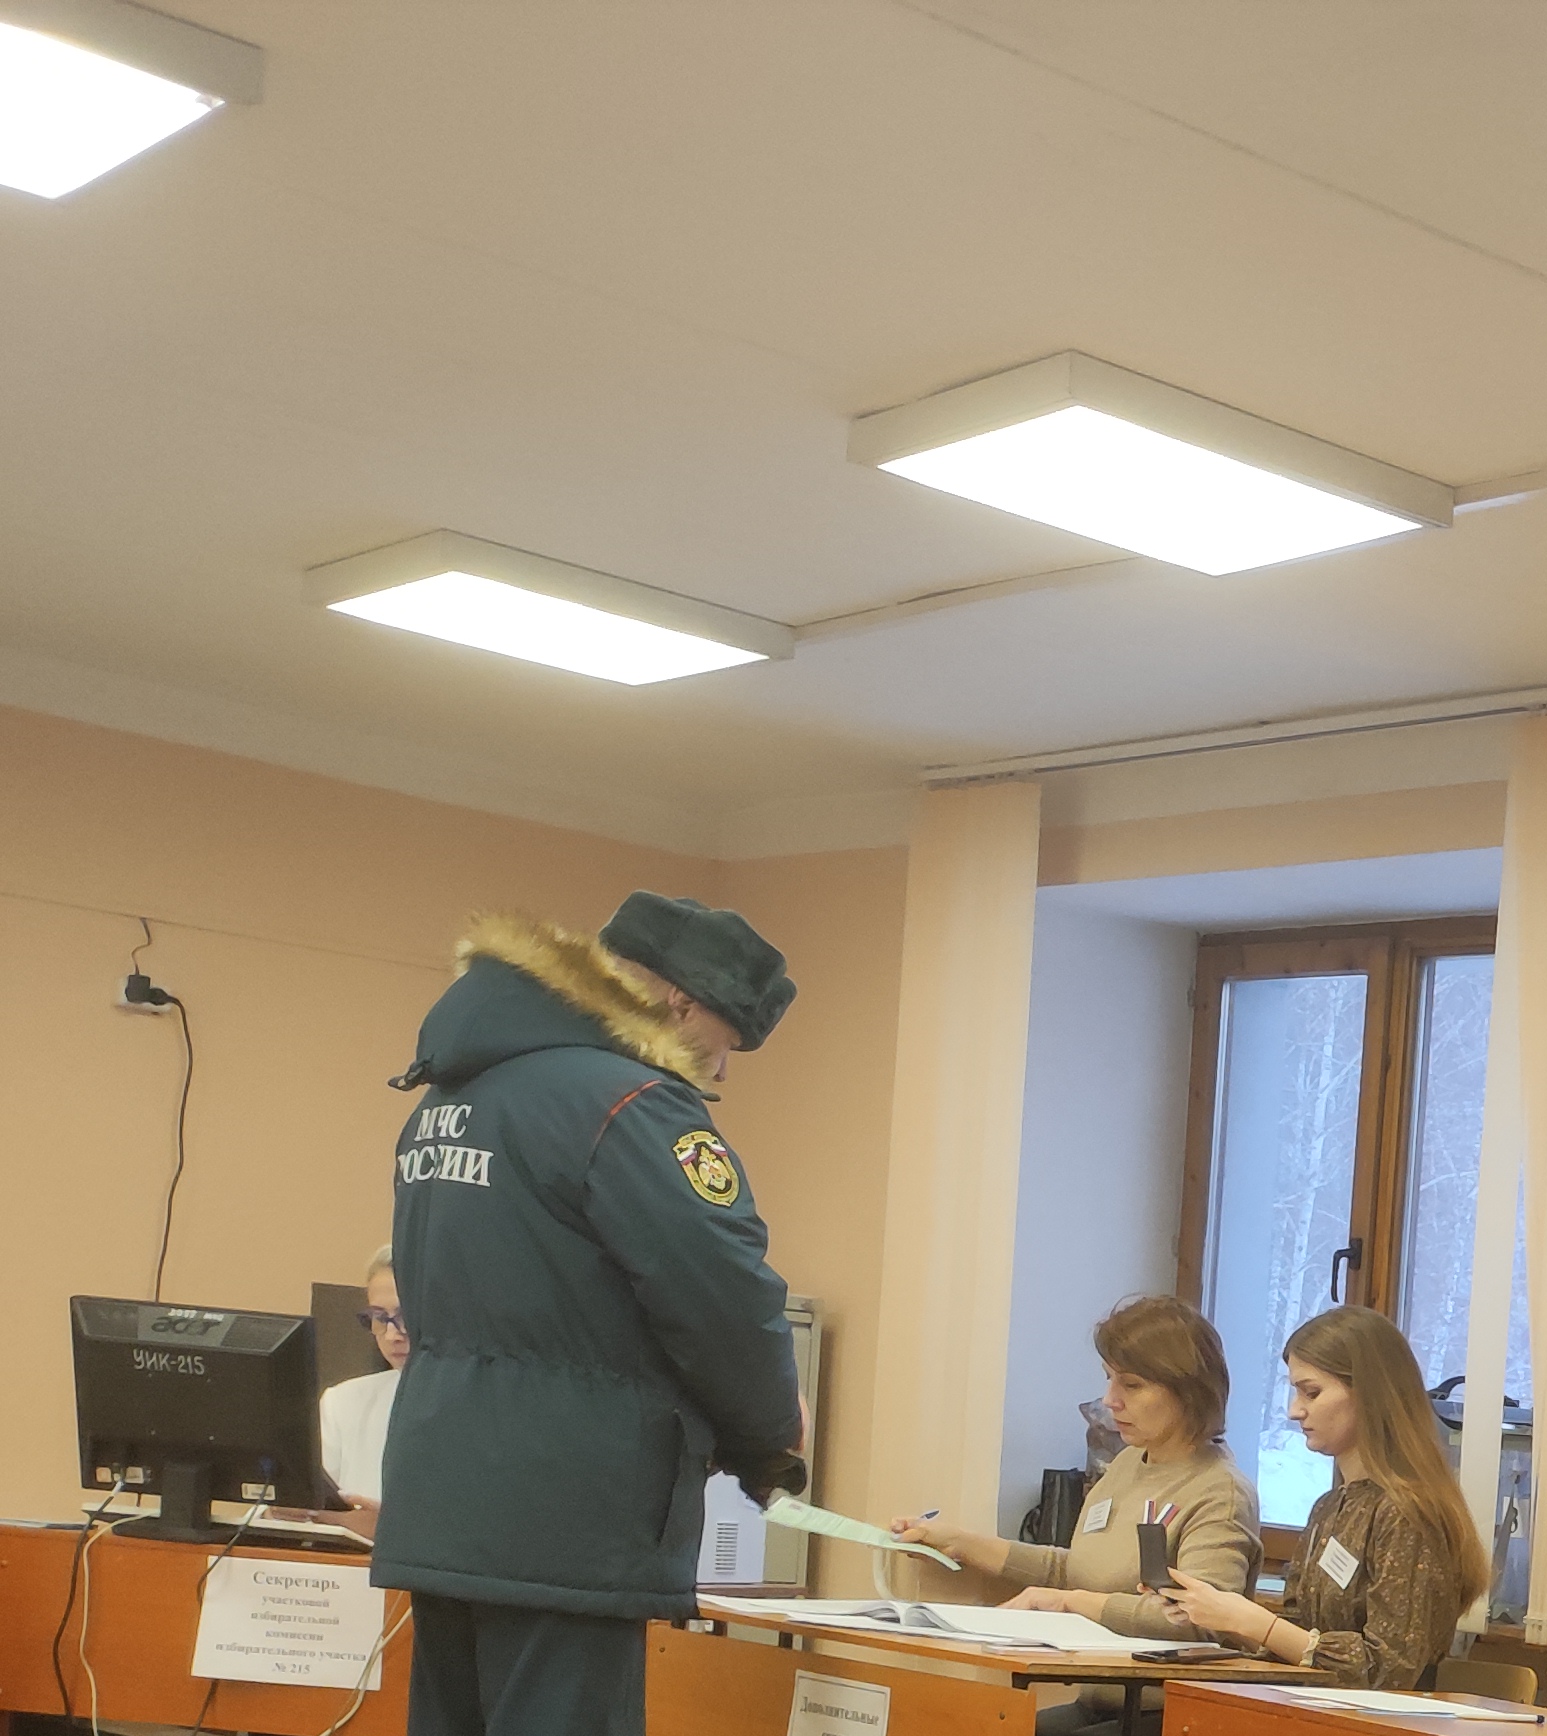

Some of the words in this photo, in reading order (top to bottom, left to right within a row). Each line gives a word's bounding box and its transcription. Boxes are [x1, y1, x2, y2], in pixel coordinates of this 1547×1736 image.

[414, 1104, 472, 1141] МЧС
[133, 1348, 205, 1375] УИК-215
[253, 1571, 340, 1592] Секретарь
[261, 1595, 330, 1608] участковой
[250, 1612, 340, 1625] избирательной
[265, 1630, 324, 1641] комиссии
[215, 1643, 316, 1658] избирательного
[289, 1664, 310, 1675] 215
[800, 1696, 879, 1726] Дополнительные
